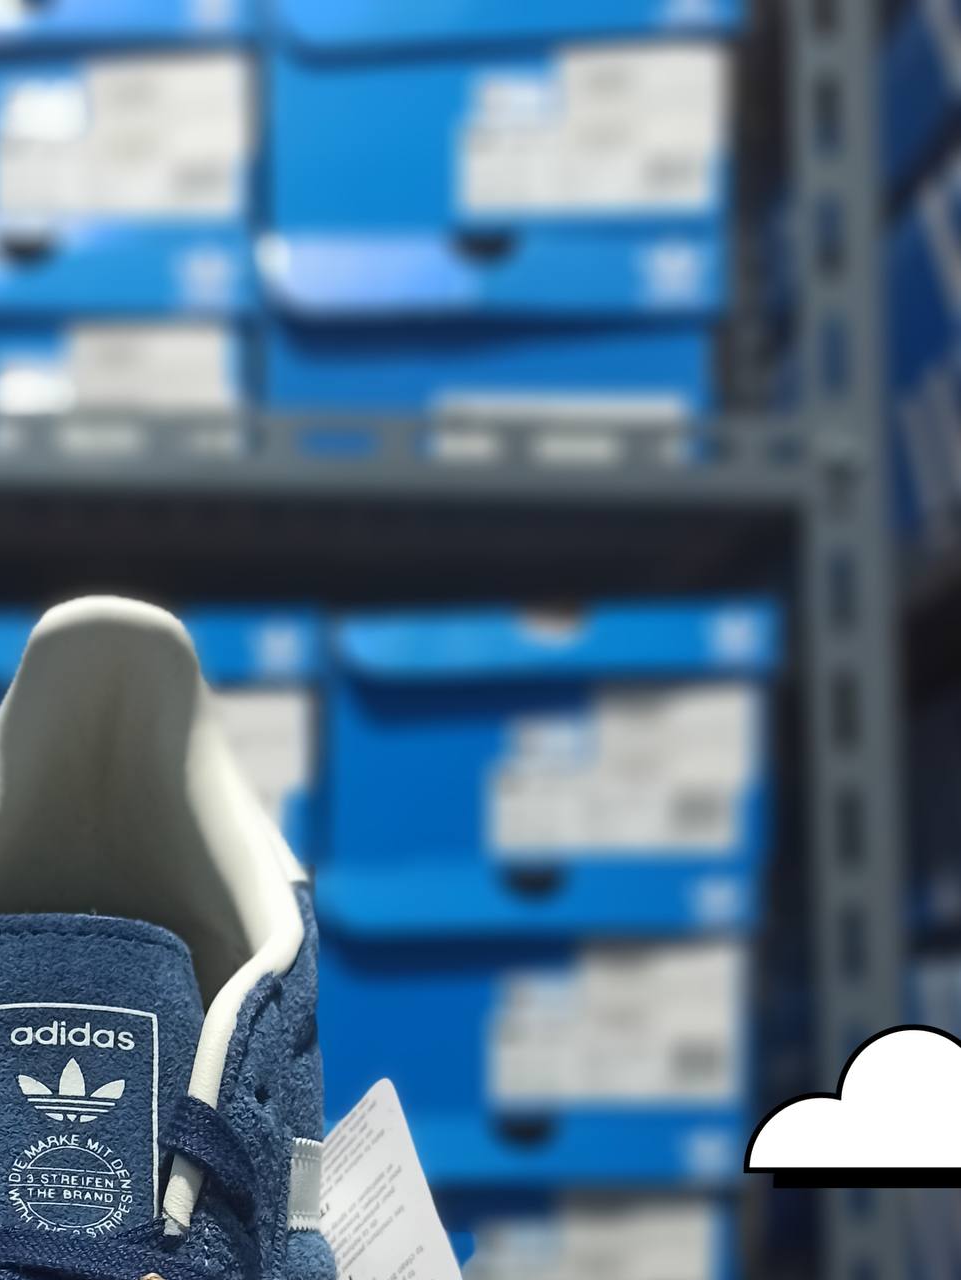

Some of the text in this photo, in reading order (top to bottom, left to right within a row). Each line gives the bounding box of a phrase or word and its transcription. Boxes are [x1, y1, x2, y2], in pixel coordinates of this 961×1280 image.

[10, 1021, 135, 1050] adidas
[8, 1134, 132, 1190] DIE MARKE MIT DEN
[26, 1173, 115, 1189] 3 STREIFEN
[27, 1188, 114, 1203] THE BRAND
[86, 1194, 133, 1239] STRIPES
[397, 1252, 416, 1275] clean
